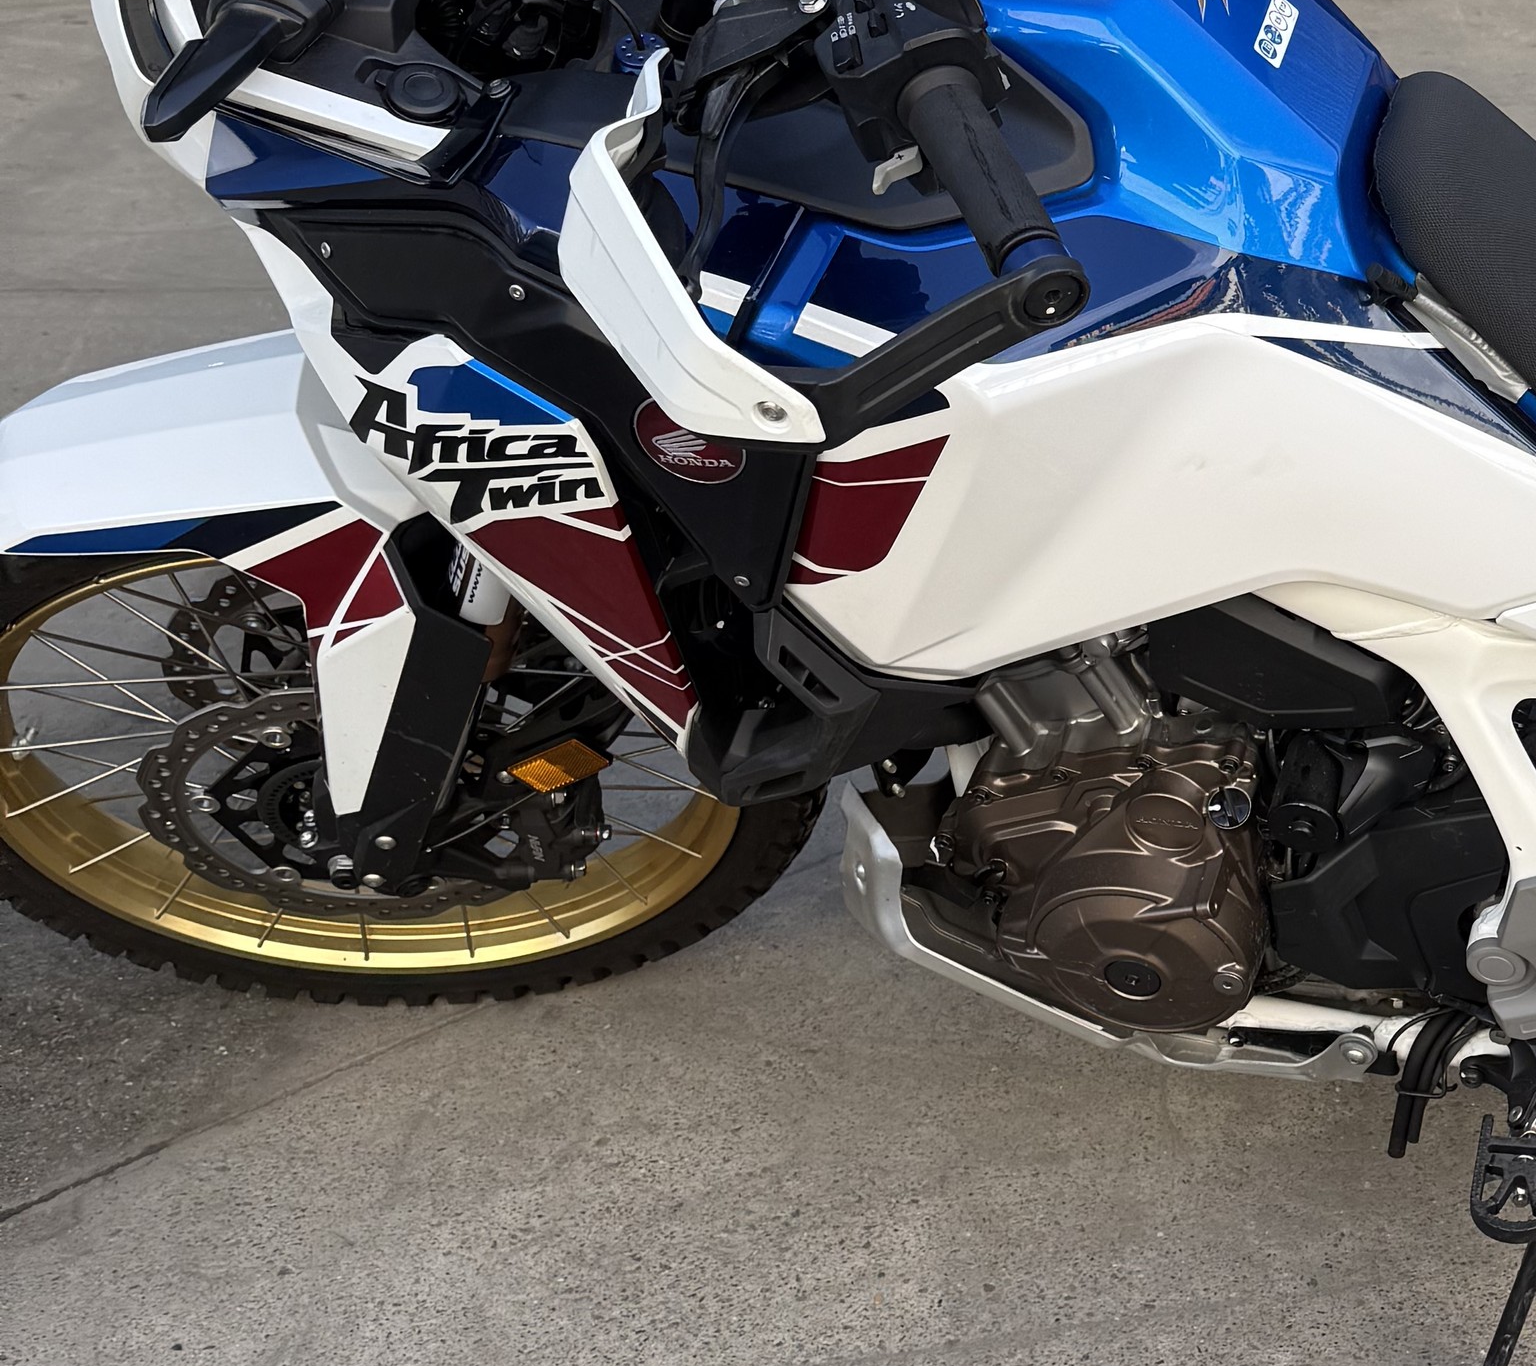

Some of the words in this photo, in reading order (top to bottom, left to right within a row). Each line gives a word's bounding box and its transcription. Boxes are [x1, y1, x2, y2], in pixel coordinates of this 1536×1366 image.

[348, 375, 589, 475] Africa
[658, 454, 736, 469] HONDA
[416, 462, 605, 525] Twin
